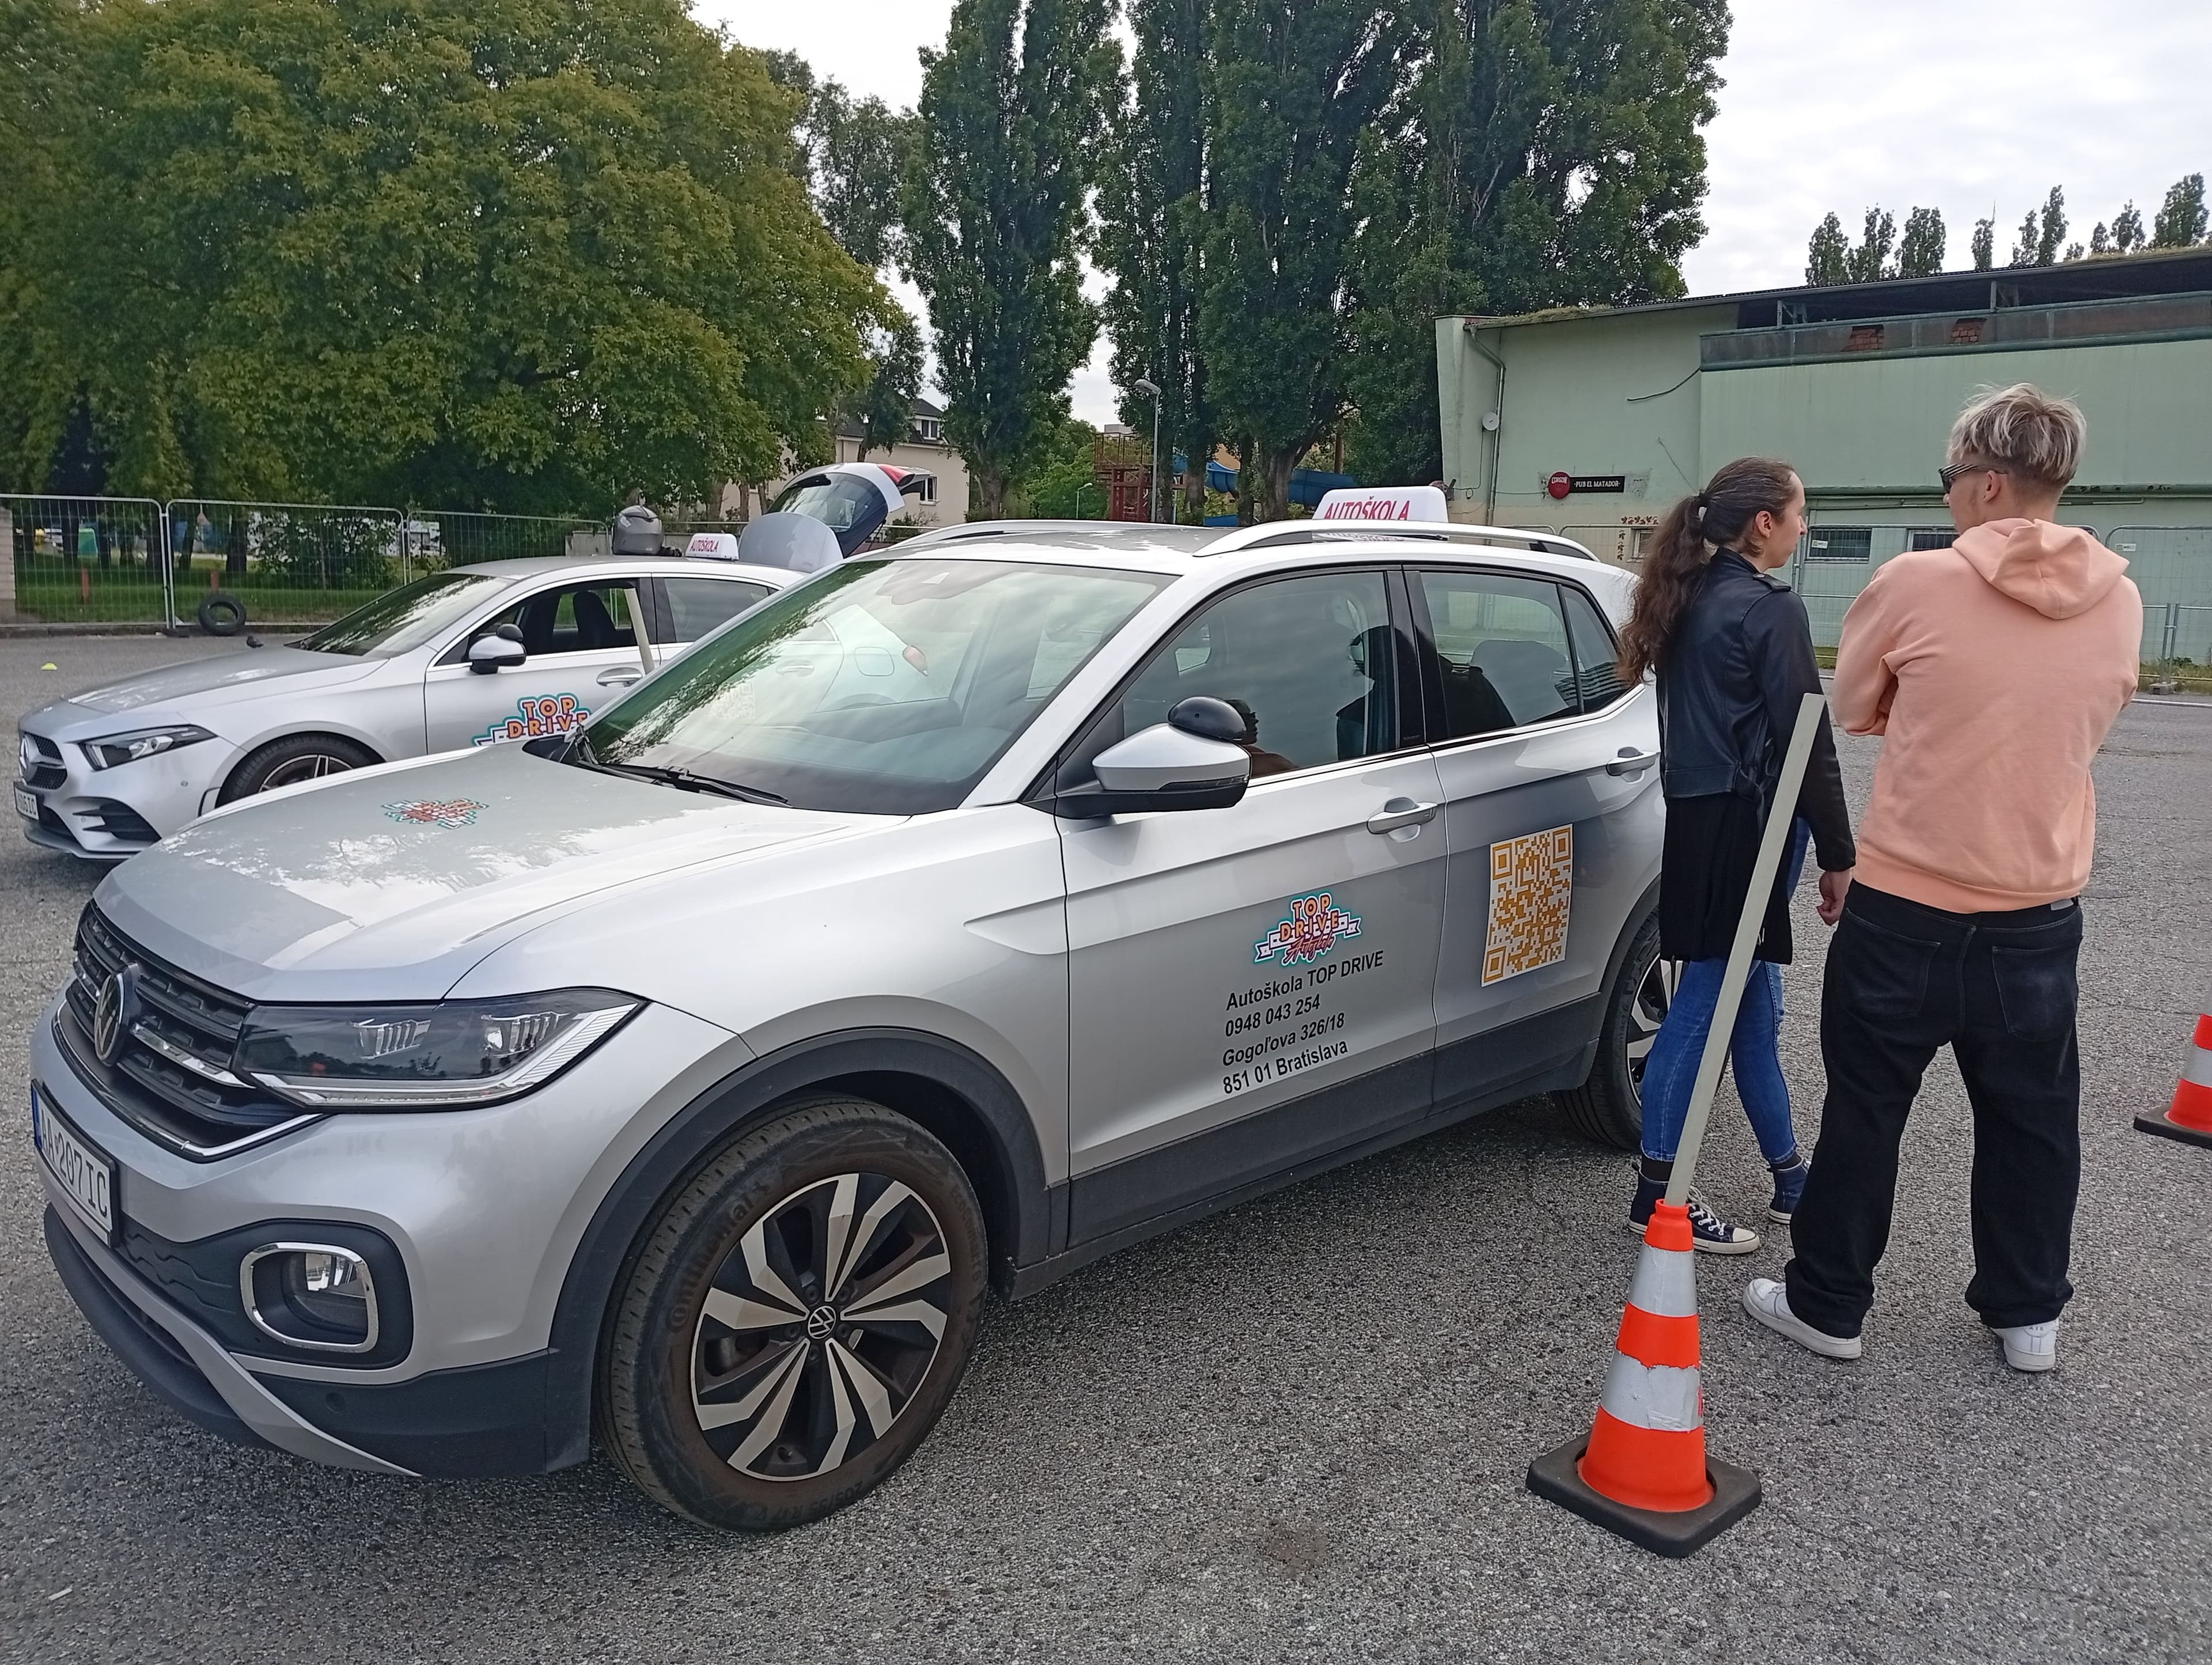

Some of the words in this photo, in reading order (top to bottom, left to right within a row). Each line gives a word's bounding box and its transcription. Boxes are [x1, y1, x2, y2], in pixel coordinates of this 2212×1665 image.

[1324, 496, 1410, 520] AUTOŠKOLA
[522, 697, 575, 718] TOP
[1293, 894, 1331, 919] TOP
[1280, 911, 1339, 942] DRIVE
[1226, 976, 1303, 1011] Autoškola
[1307, 964, 1337, 987] TOP
[1340, 950, 1384, 977] DRIVE
[1225, 1012, 1261, 1037] 0948
[1266, 1003, 1291, 1025] 043
[1295, 993, 1320, 1016] 254
[1222, 1032, 1296, 1066] Gogoľova
[1300, 1012, 1345, 1041] 326/18
[1223, 1069, 1249, 1094] 851
[1254, 1063, 1272, 1083] 01
[1275, 1040, 1349, 1076] Bratislava
